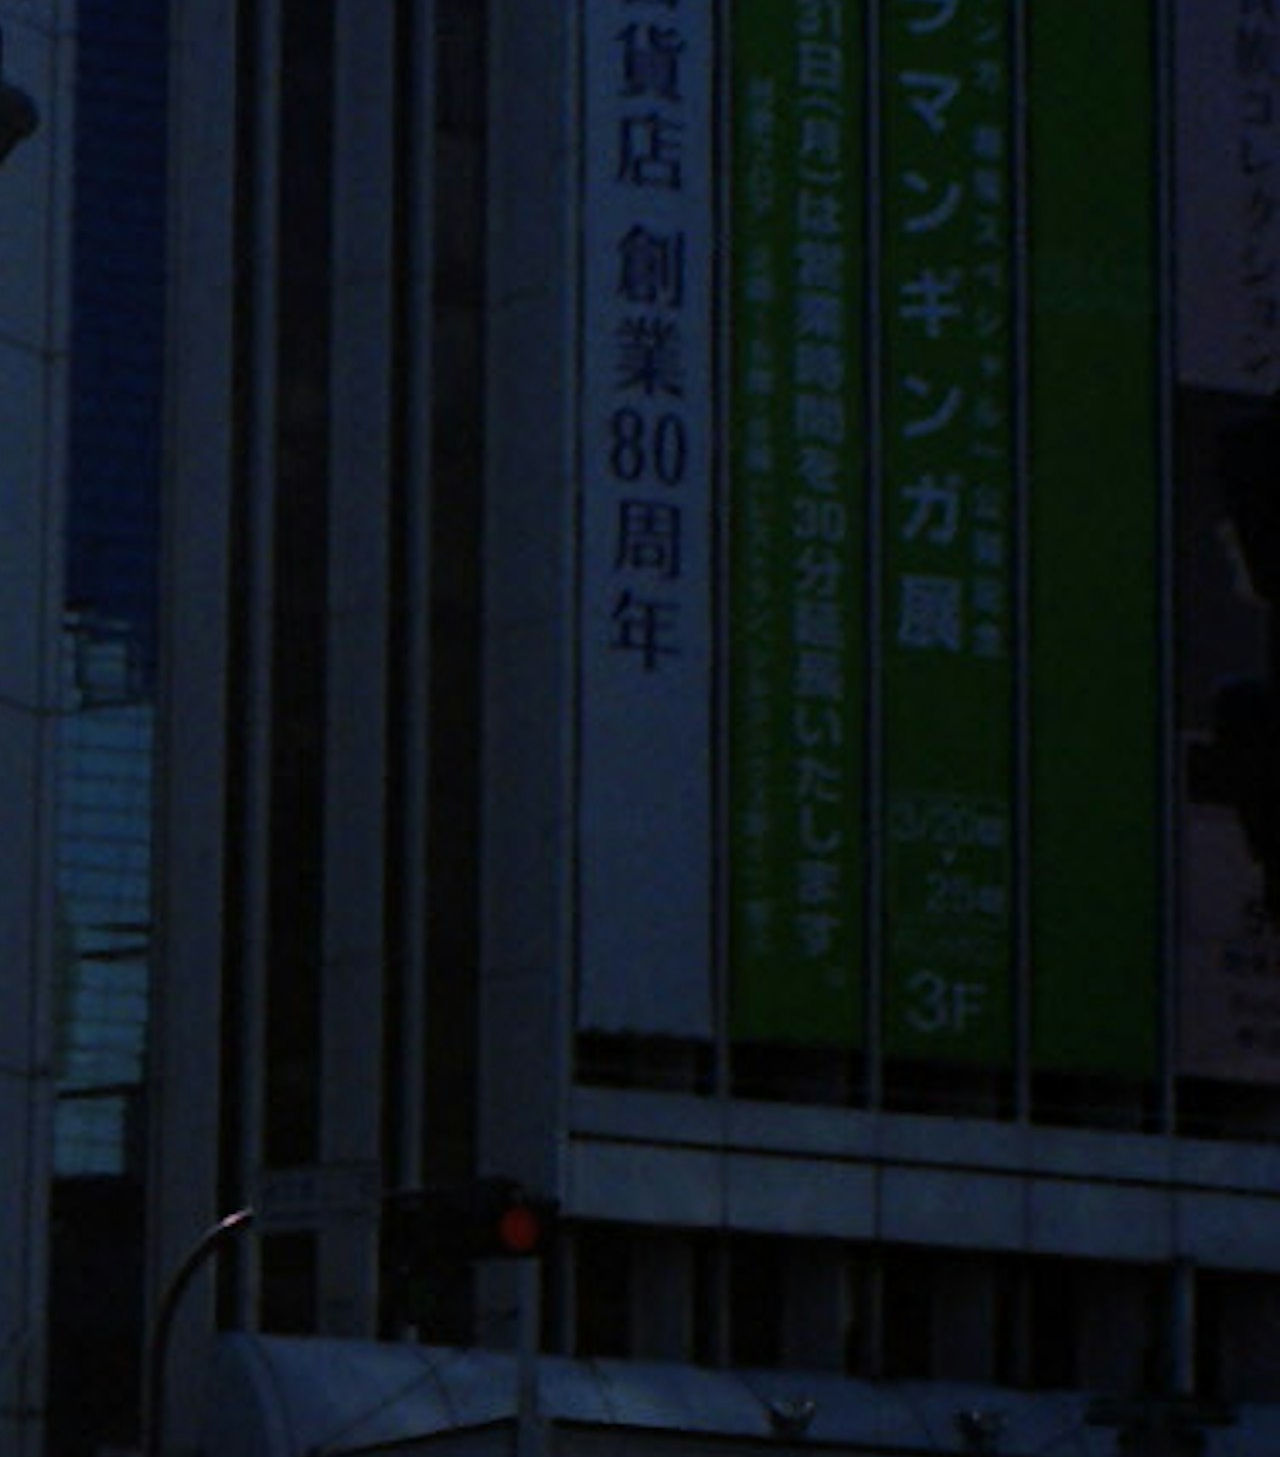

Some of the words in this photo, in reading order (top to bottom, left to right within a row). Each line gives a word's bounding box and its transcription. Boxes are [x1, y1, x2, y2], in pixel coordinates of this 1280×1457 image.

[608, 225, 690, 672] 創業80周年
[905, 967, 988, 1036] 3F
